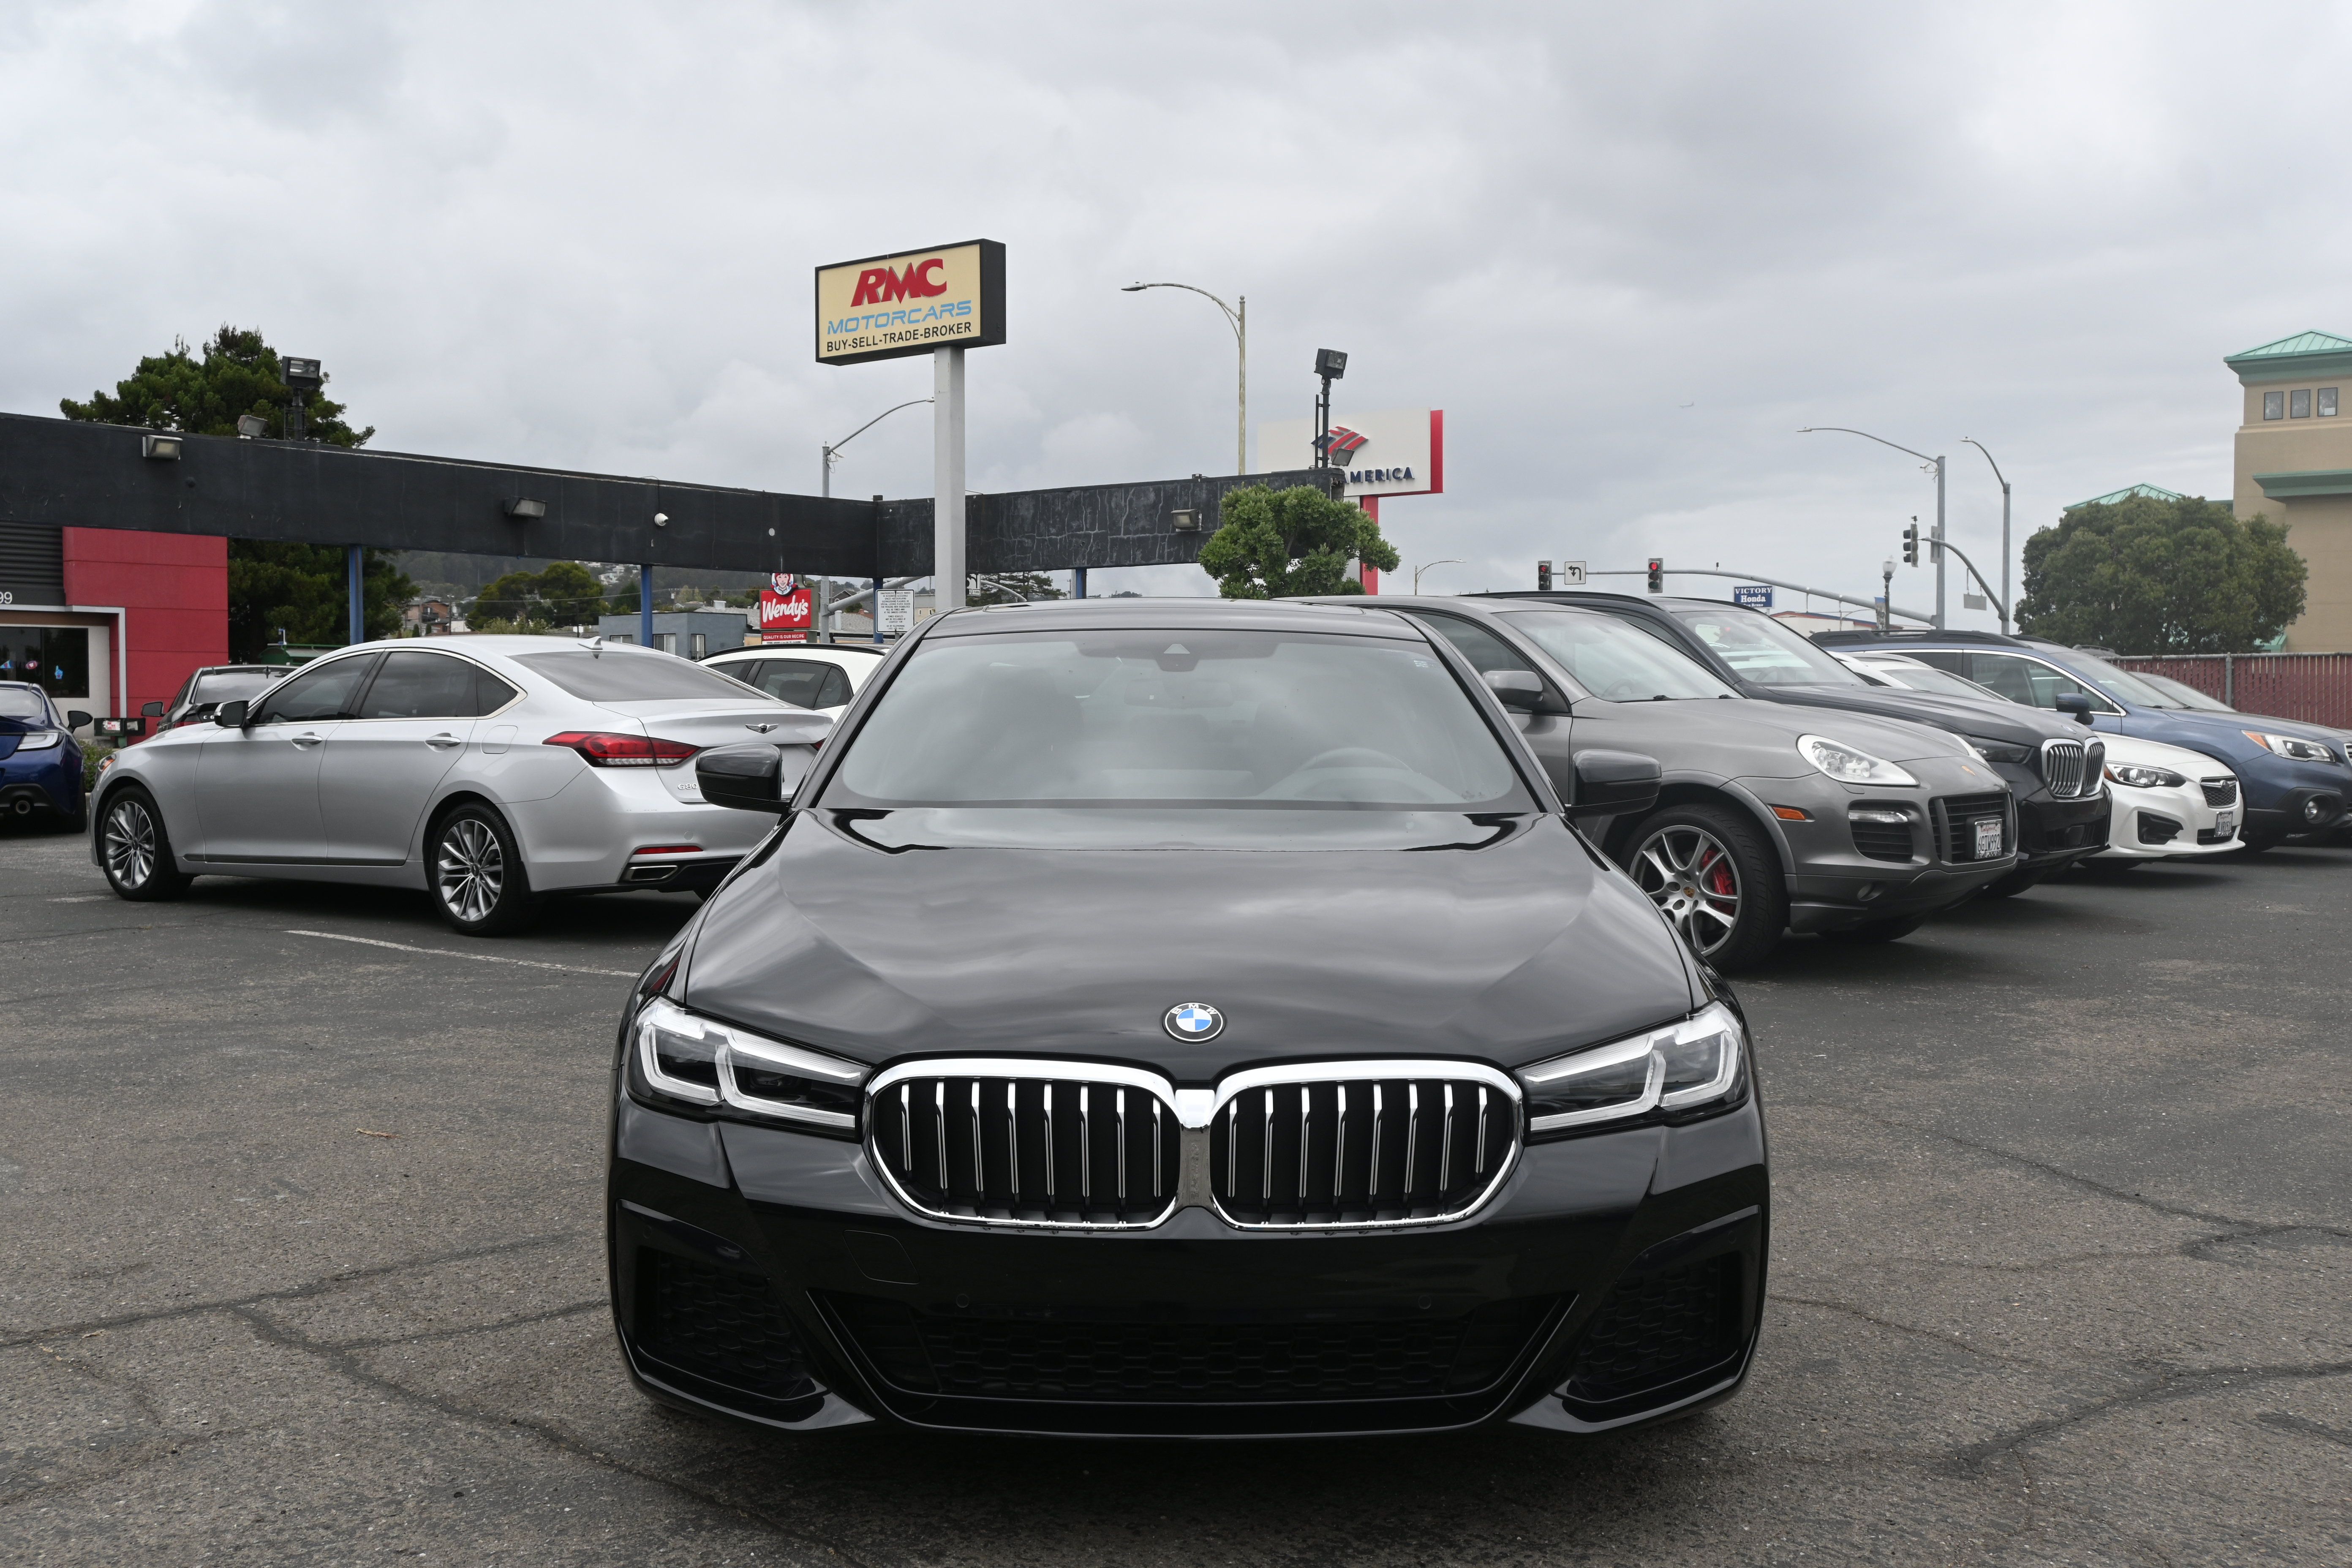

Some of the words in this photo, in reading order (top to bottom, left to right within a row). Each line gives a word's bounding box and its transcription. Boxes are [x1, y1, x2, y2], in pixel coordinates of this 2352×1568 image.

[850, 258, 947, 307] RMC
[827, 300, 972, 335] MOTORCARS
[827, 321, 972, 352] BUY-SELL-TRADE-BROKER
[1345, 466, 1415, 484] MERICA
[762, 595, 808, 623] Wendy's
[1171, 1004, 1218, 1015] BMW
